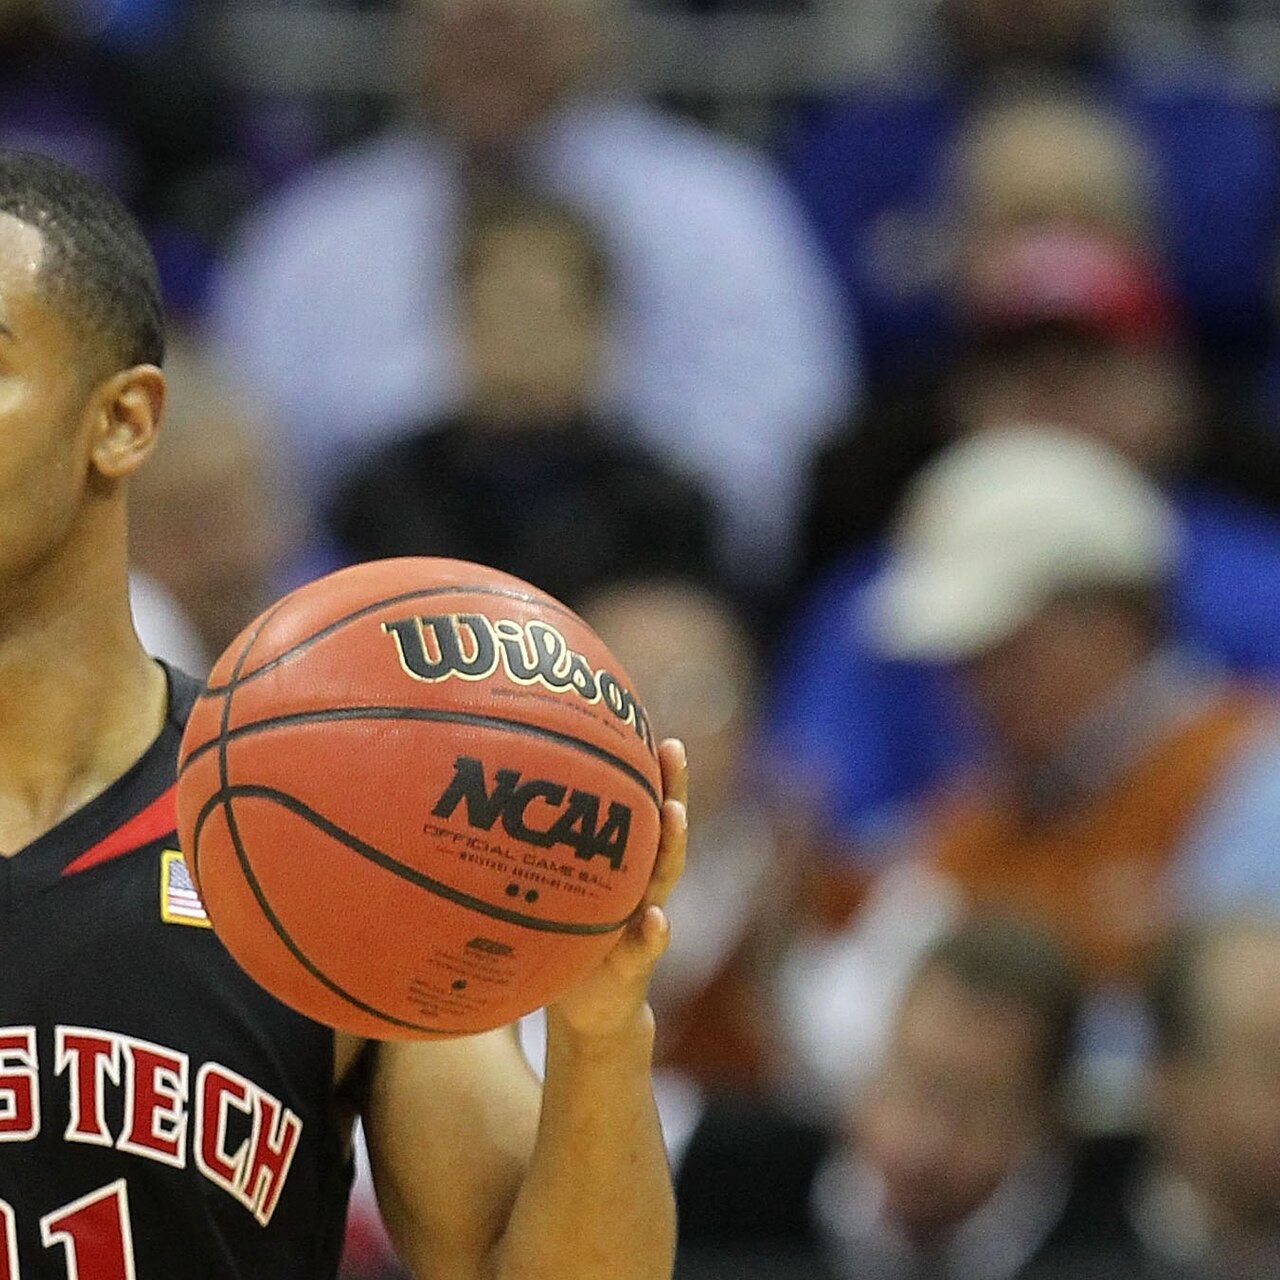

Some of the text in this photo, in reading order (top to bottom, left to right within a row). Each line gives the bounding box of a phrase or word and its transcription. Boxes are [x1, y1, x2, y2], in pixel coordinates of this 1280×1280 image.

[381, 613, 656, 757] Wilson
[423, 823, 517, 861] OFFICIAL
[431, 755, 631, 871] NCAA
[54, 1025, 303, 1228] TECH
